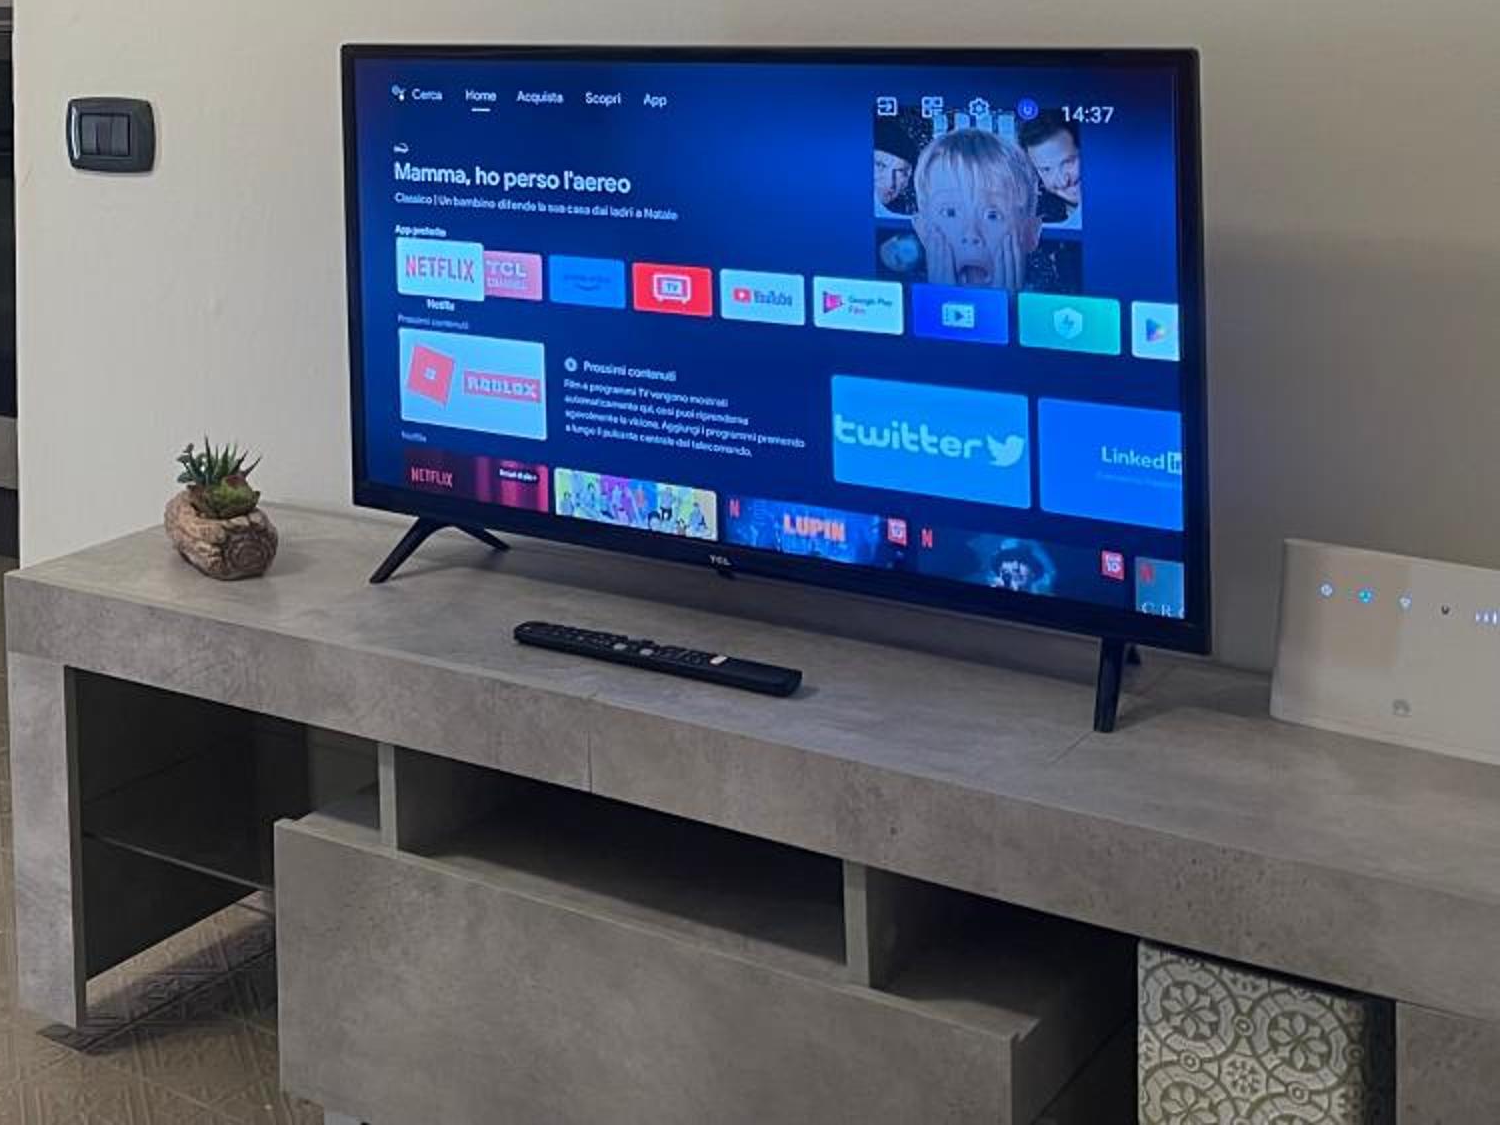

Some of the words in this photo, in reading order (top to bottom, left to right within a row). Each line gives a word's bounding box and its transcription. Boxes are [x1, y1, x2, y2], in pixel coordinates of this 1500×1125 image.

[411, 88, 443, 101] Cerca
[464, 88, 497, 102] Home
[515, 90, 564, 106] Acquista
[585, 91, 621, 108] Scopri
[643, 93, 668, 109] App
[1061, 105, 1115, 124] 14:37
[394, 161, 471, 186] Mamma,
[475, 166, 500, 186] ho
[503, 171, 560, 192] perso
[563, 170, 631, 193] l'aereo
[405, 254, 475, 284] NETFLIX
[485, 258, 527, 278] TCL
[665, 282, 679, 293] TV
[753, 289, 793, 307] YouTube
[583, 360, 627, 377] Prossimi
[627, 368, 677, 382] contenuti
[467, 376, 536, 398] ROBLOX
[834, 415, 981, 459] twitter
[411, 467, 453, 487] NETFLIX
[783, 513, 846, 543] LUPIN
[710, 555, 731, 566] TCL
